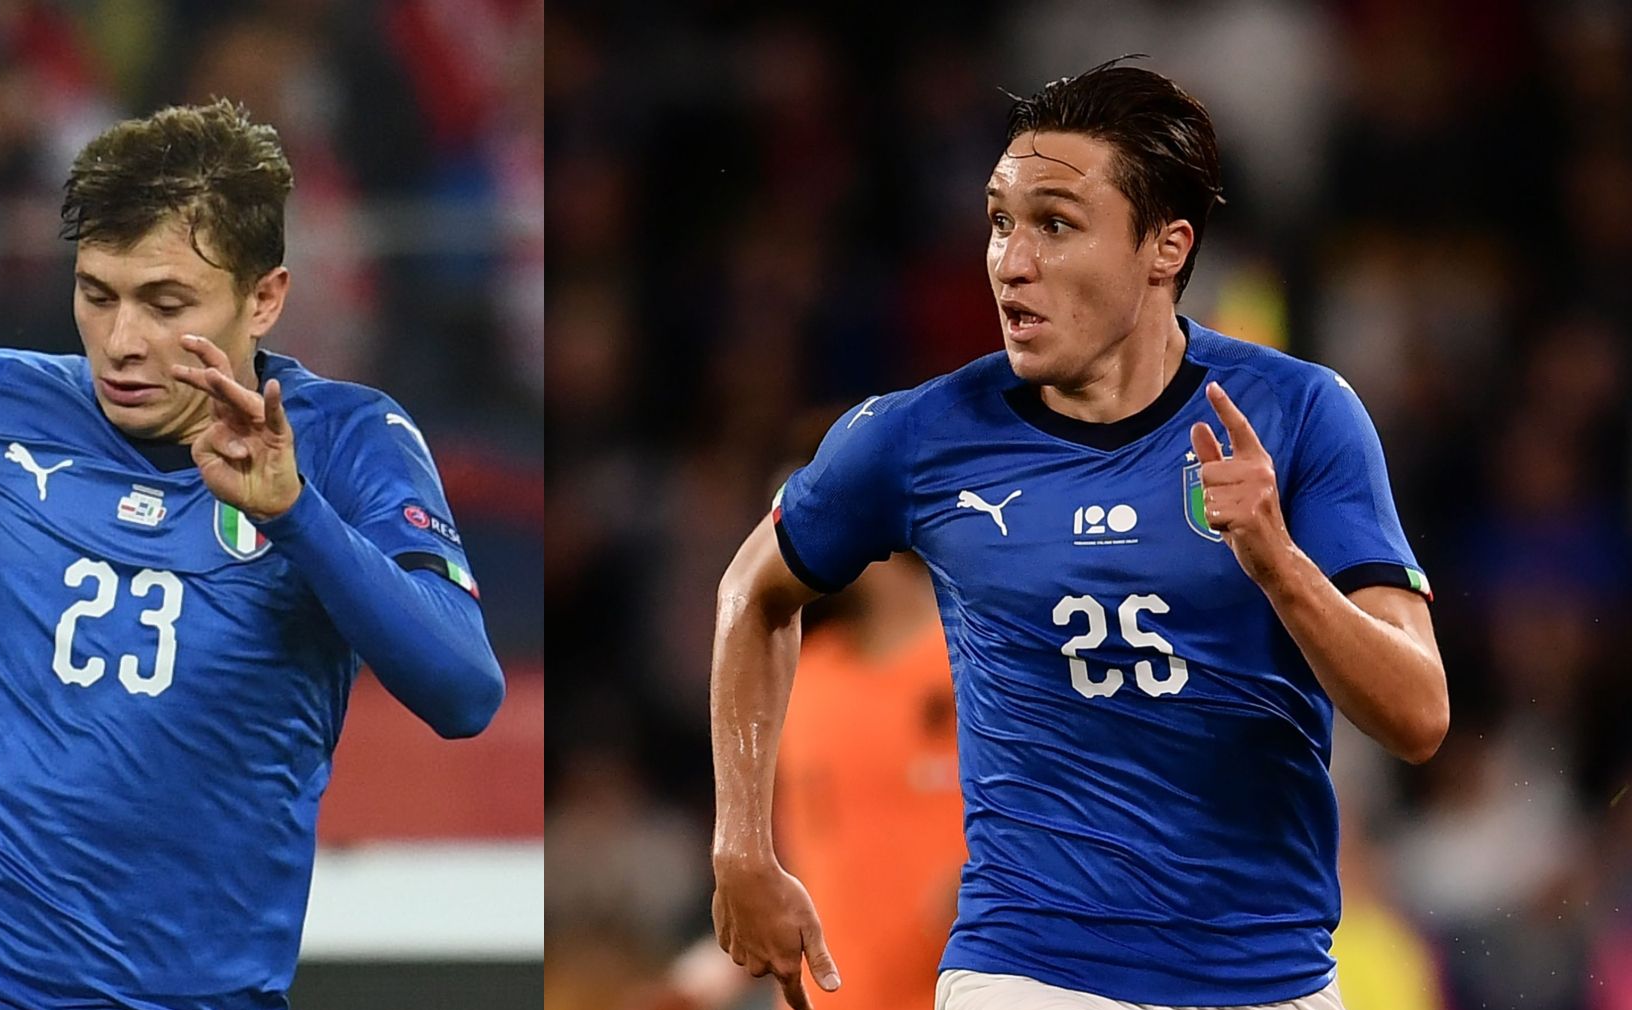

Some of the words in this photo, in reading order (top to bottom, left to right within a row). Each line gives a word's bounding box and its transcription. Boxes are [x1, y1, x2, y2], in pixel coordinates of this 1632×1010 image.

[1073, 504, 1137, 535] 120
[52, 557, 184, 697] 23
[1052, 594, 1189, 698] 25
